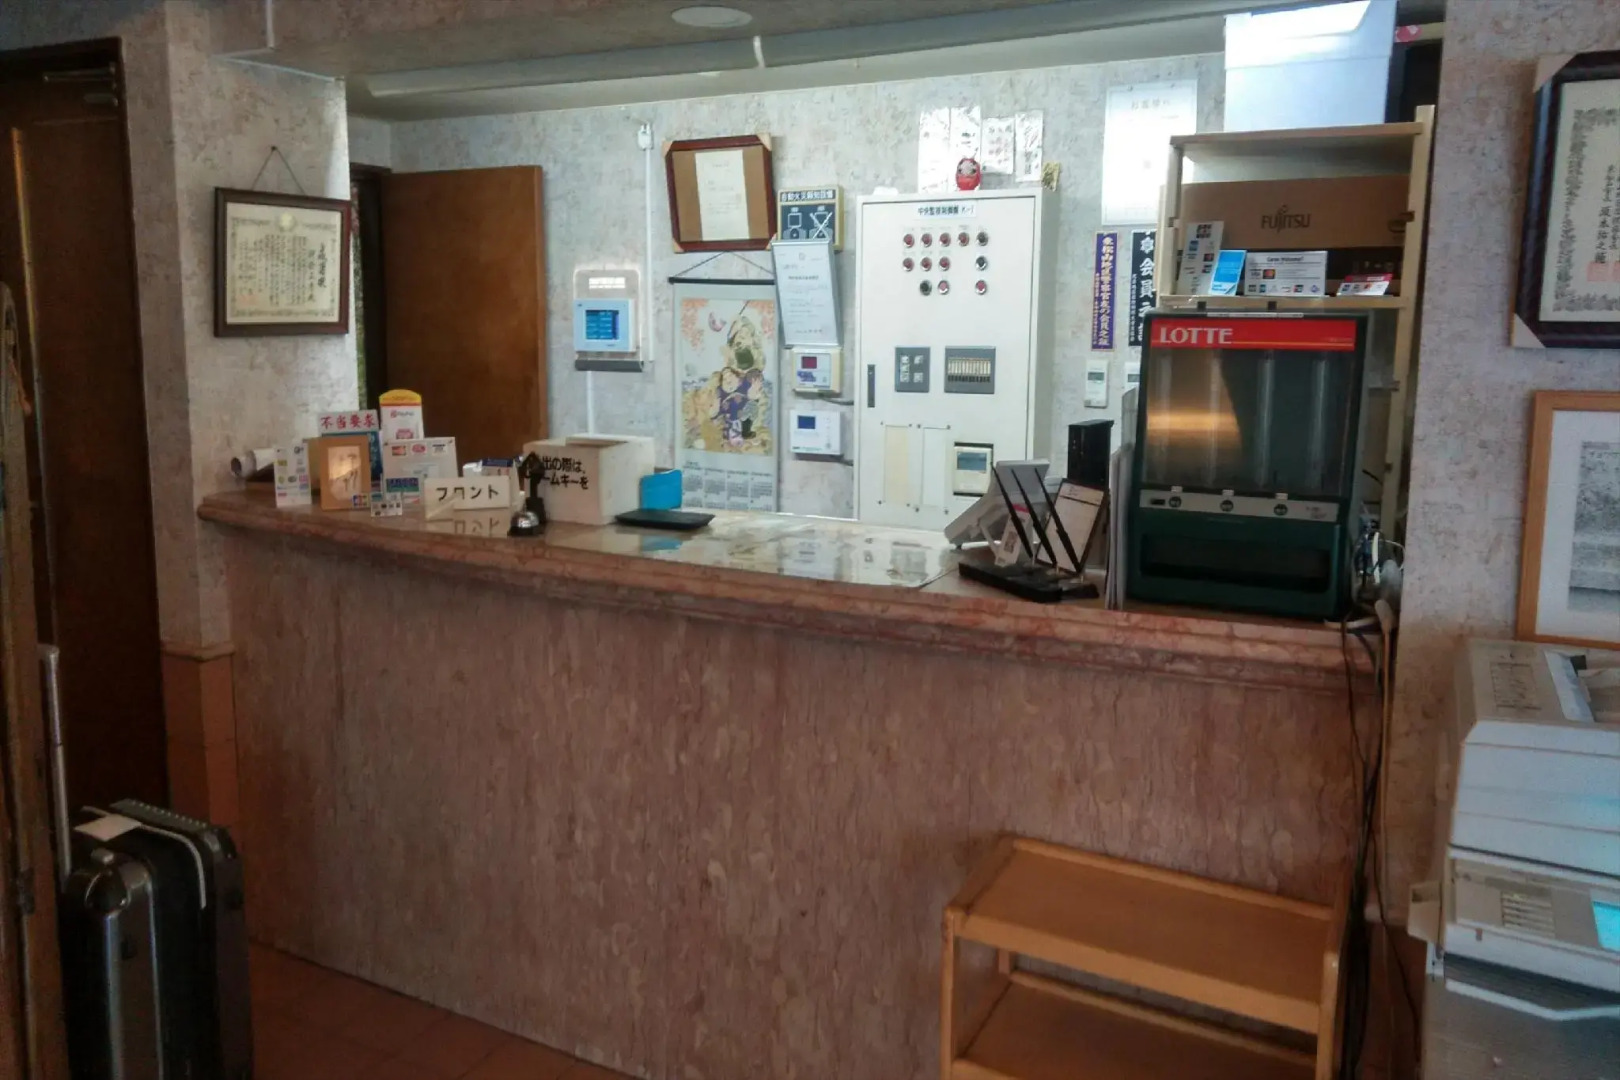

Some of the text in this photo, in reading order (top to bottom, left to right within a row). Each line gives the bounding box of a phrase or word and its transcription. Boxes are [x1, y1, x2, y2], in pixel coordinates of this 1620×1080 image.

[1261, 211, 1311, 233] FUJITSU
[1160, 327, 1233, 344] LOTTE
[320, 413, 375, 430] 不当要求
[542, 472, 589, 490] ームキーを
[436, 484, 499, 501] フロント
